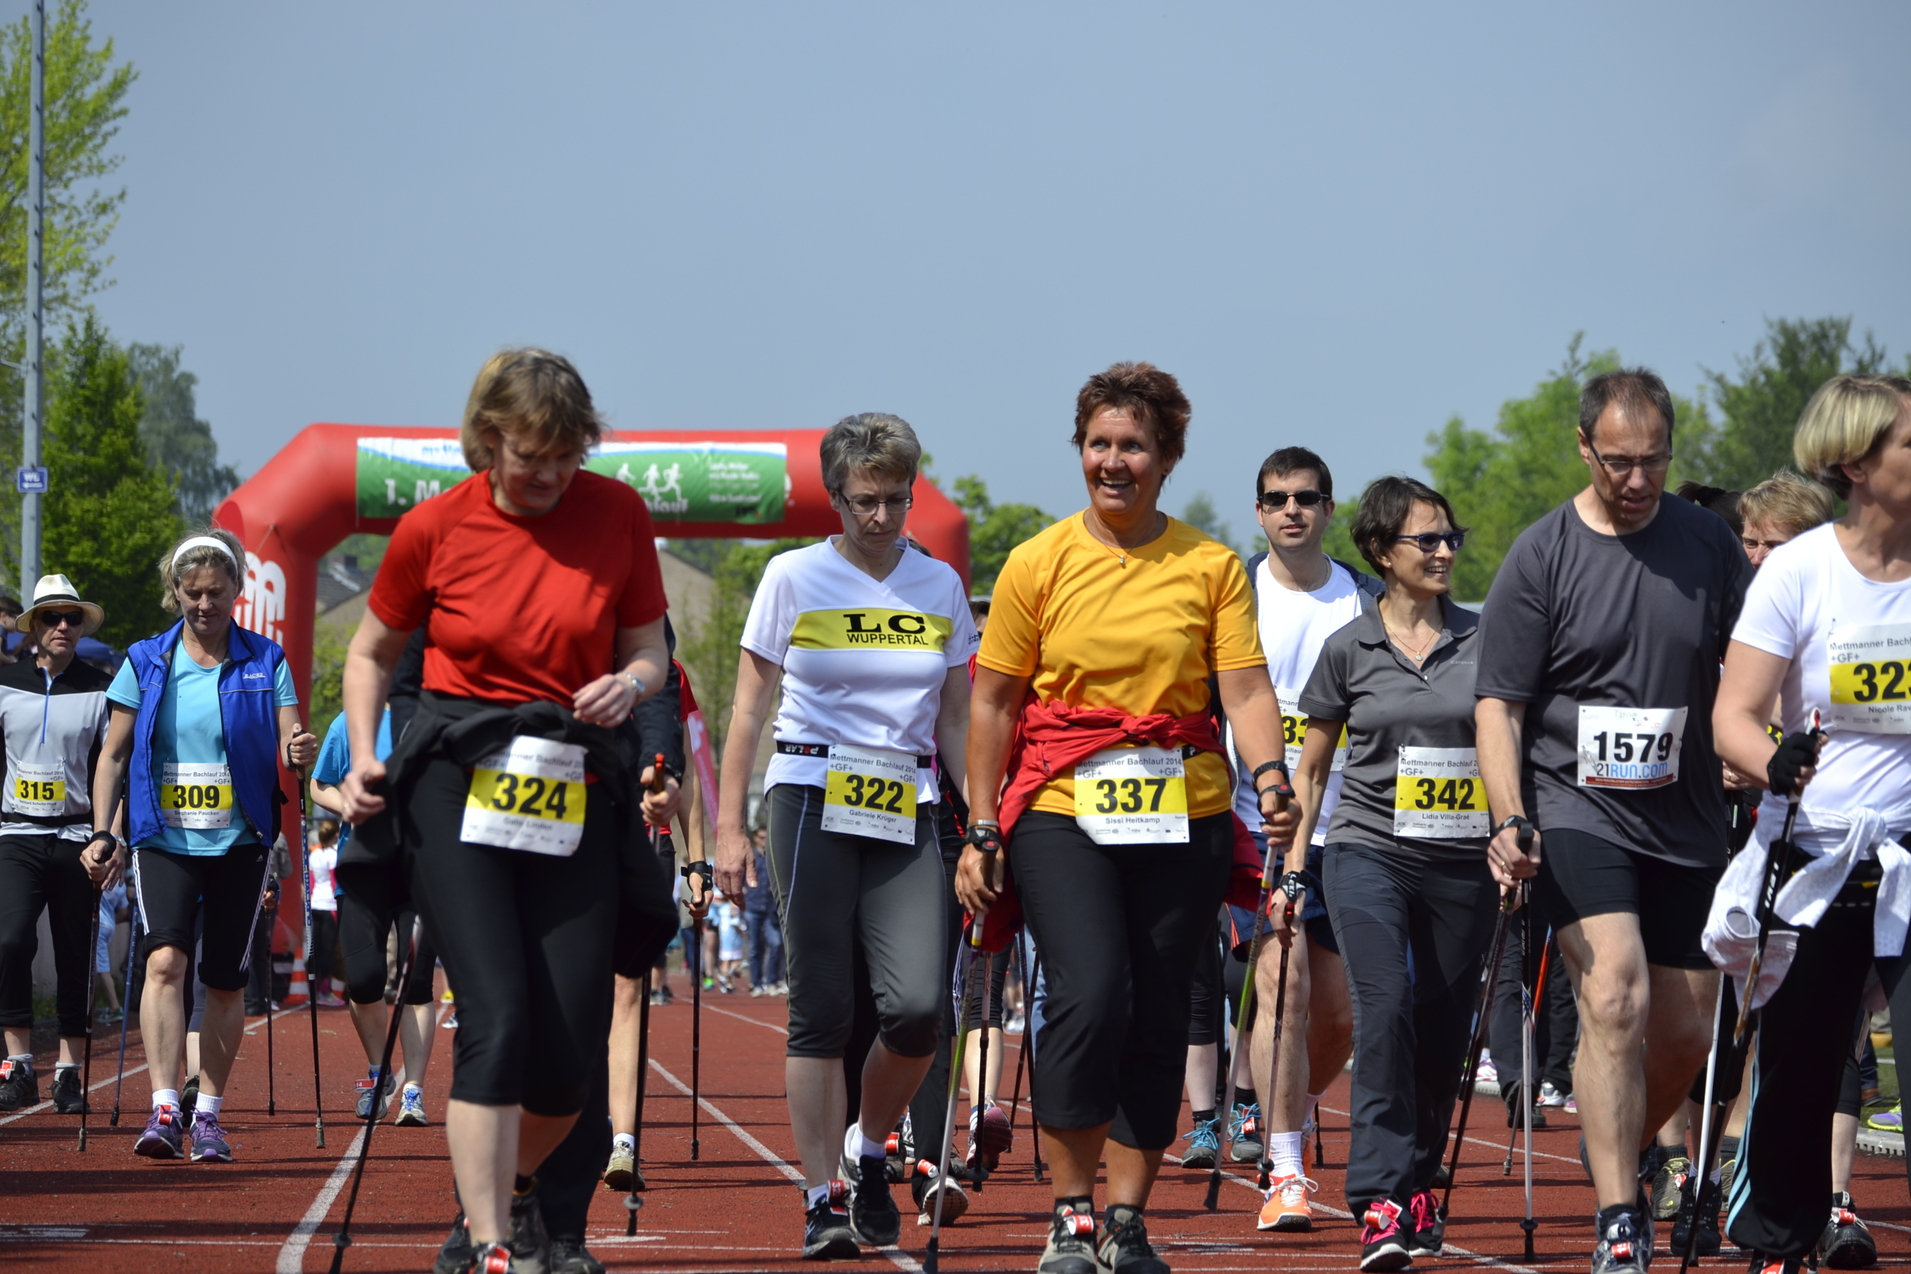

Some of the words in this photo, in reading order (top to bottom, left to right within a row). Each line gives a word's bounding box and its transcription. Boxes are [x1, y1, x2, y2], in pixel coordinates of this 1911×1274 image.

[843, 614, 926, 634] LC
[847, 633, 929, 646] WUPPERTAL
[1829, 641, 1885, 651] Mettmanner
[1831, 653, 1860, 663] +GF+
[1853, 661, 1911, 702] 32
[1868, 706, 1895, 714] Nicole
[1896, 704, 1911, 712] Rav
[785, 744, 819, 754] POLAR
[1593, 731, 1674, 763] 1579
[830, 753, 874, 766] Mettmanner
[876, 760, 905, 771] Bachlauf
[905, 765, 917, 774] 2014
[830, 763, 853, 772] +GF+
[1076, 759, 1125, 768] Mettmanner
[1127, 757, 1164, 765] Bachlauf
[1400, 759, 1445, 768] Mettmanner
[1447, 760, 1473, 768] Bachlauf
[1077, 770, 1102, 778] +GF+
[1159, 767, 1183, 776] +GF+
[1400, 768, 1424, 776] +GF+
[899, 774, 916, 783] +GF+
[20, 780, 54, 800] 315
[492, 773, 568, 819] 324
[844, 774, 904, 814] 322
[1096, 778, 1167, 813] 337
[1415, 778, 1475, 810] 342
[172, 785, 220, 809] 309
[849, 809, 876, 820] Gabriele
[877, 813, 897, 823] Krüger
[1125, 816, 1160, 825] Heitkamp
